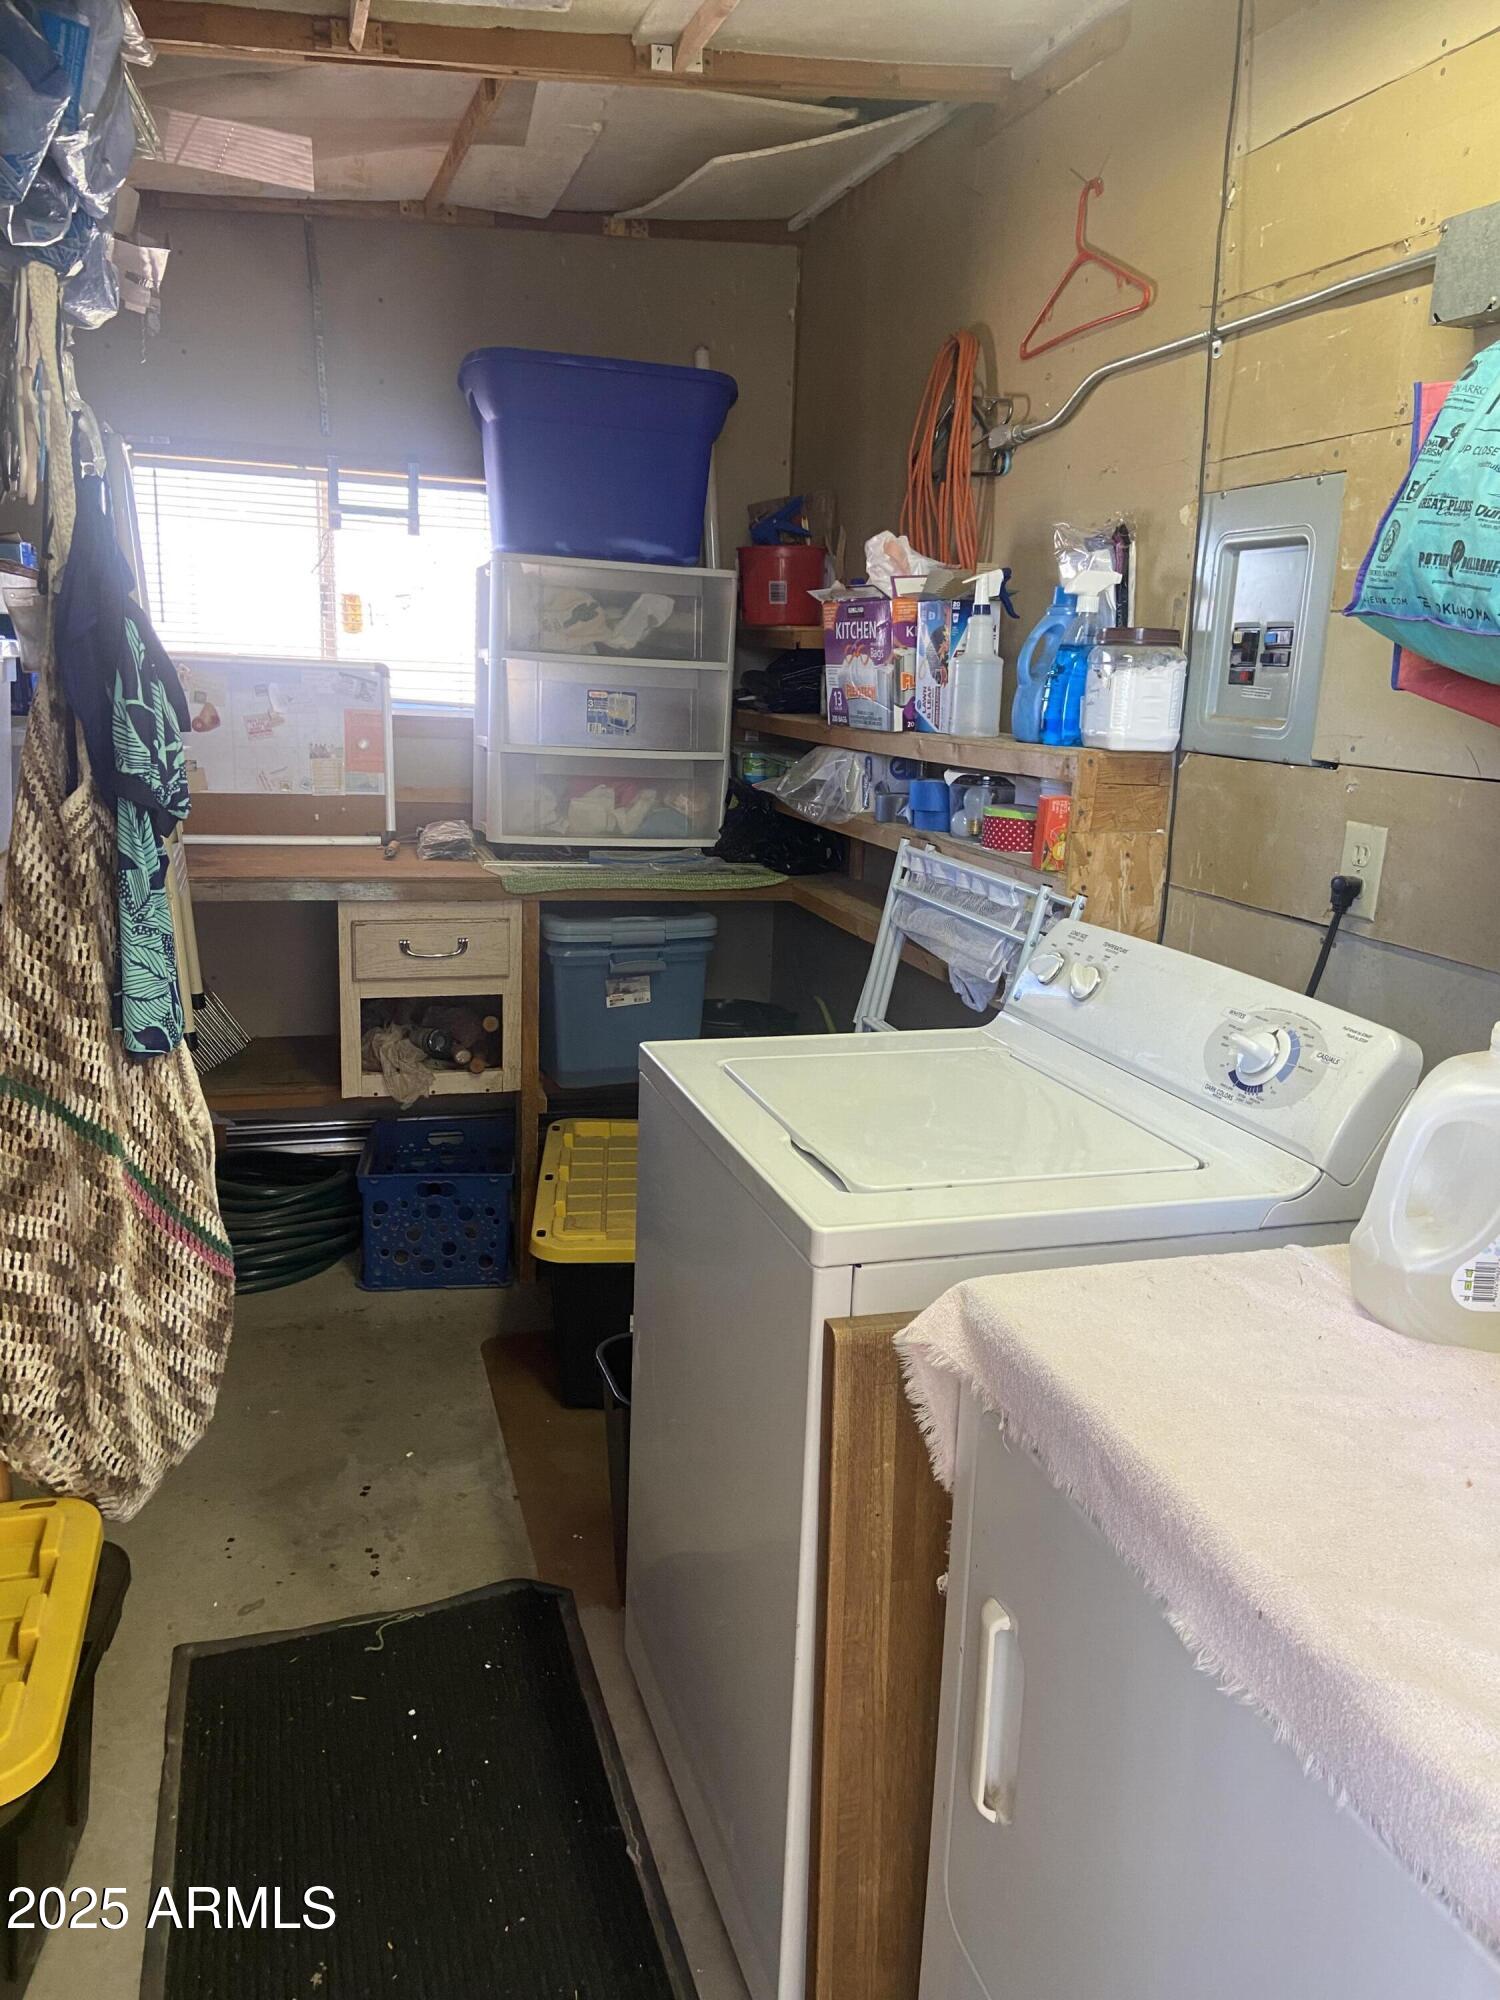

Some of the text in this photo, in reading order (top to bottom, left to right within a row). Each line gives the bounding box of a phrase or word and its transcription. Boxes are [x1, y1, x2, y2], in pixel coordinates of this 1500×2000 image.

[1473, 446, 1500, 456] CLOSE
[835, 620, 877, 640] KITCHEN
[870, 647, 884, 660] Bags
[587, 700, 594, 708] 3
[833, 690, 842, 706] 13
[1228, 1009, 1247, 1020] WHITES
[1316, 1051, 1341, 1065] CASUALS
[1204, 1083, 1217, 1093] DARK
[1216, 1088, 1235, 1101] COLORS
